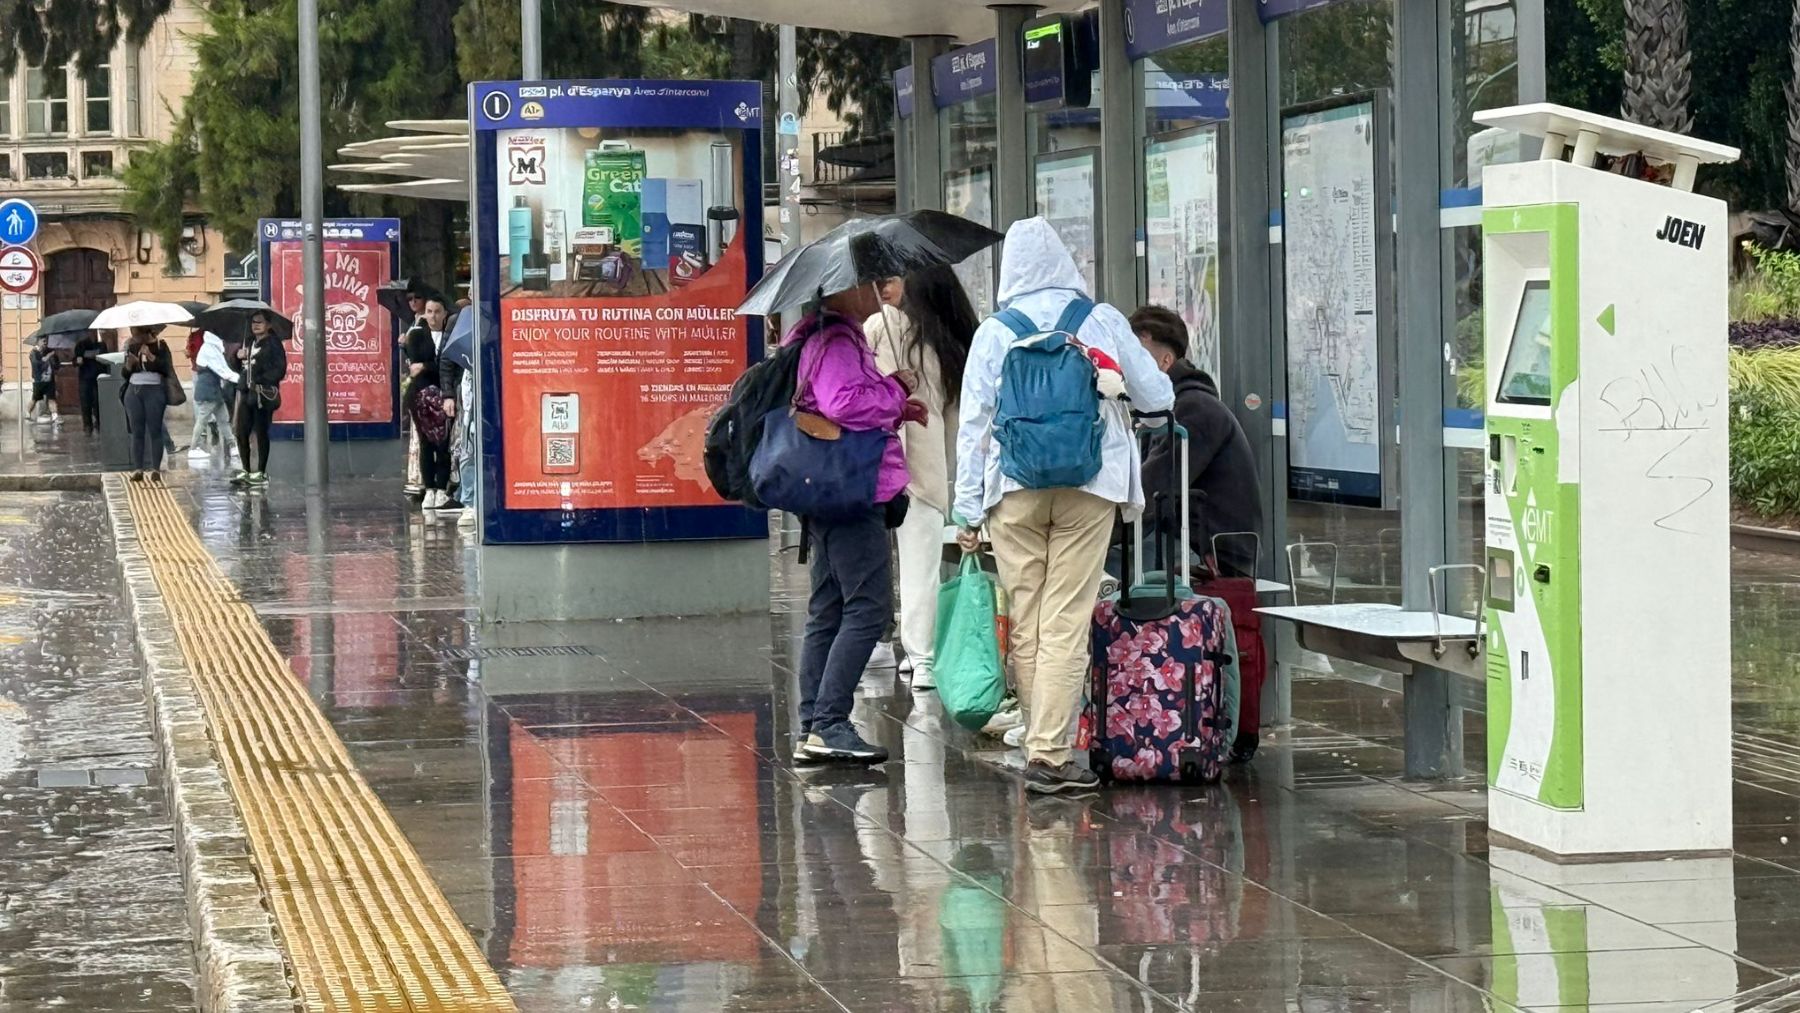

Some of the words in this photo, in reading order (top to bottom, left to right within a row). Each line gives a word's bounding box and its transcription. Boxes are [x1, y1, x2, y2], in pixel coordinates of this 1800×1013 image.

[567, 85, 631, 98] d'Espanya
[516, 157, 537, 174] M
[587, 168, 643, 181] Green
[609, 180, 642, 193] Cat
[1656, 215, 1706, 250] JOEN
[335, 252, 360, 274] NA
[511, 308, 577, 321] DISFRUTA
[579, 308, 599, 321] TU
[602, 308, 653, 321] RUTINA
[655, 307, 684, 320] CON
[686, 304, 736, 320] MÜLLER
[512, 327, 549, 341] ENJOY
[554, 327, 590, 341] YOUR
[594, 327, 651, 341] ROUTINE
[655, 327, 687, 340] WITH
[691, 324, 737, 340] MÜLLER
[327, 361, 385, 374] CONFIANÇA
[651, 384, 684, 392] TIENDAS
[697, 383, 732, 393] MALLORC
[650, 393, 678, 403] SHOPS
